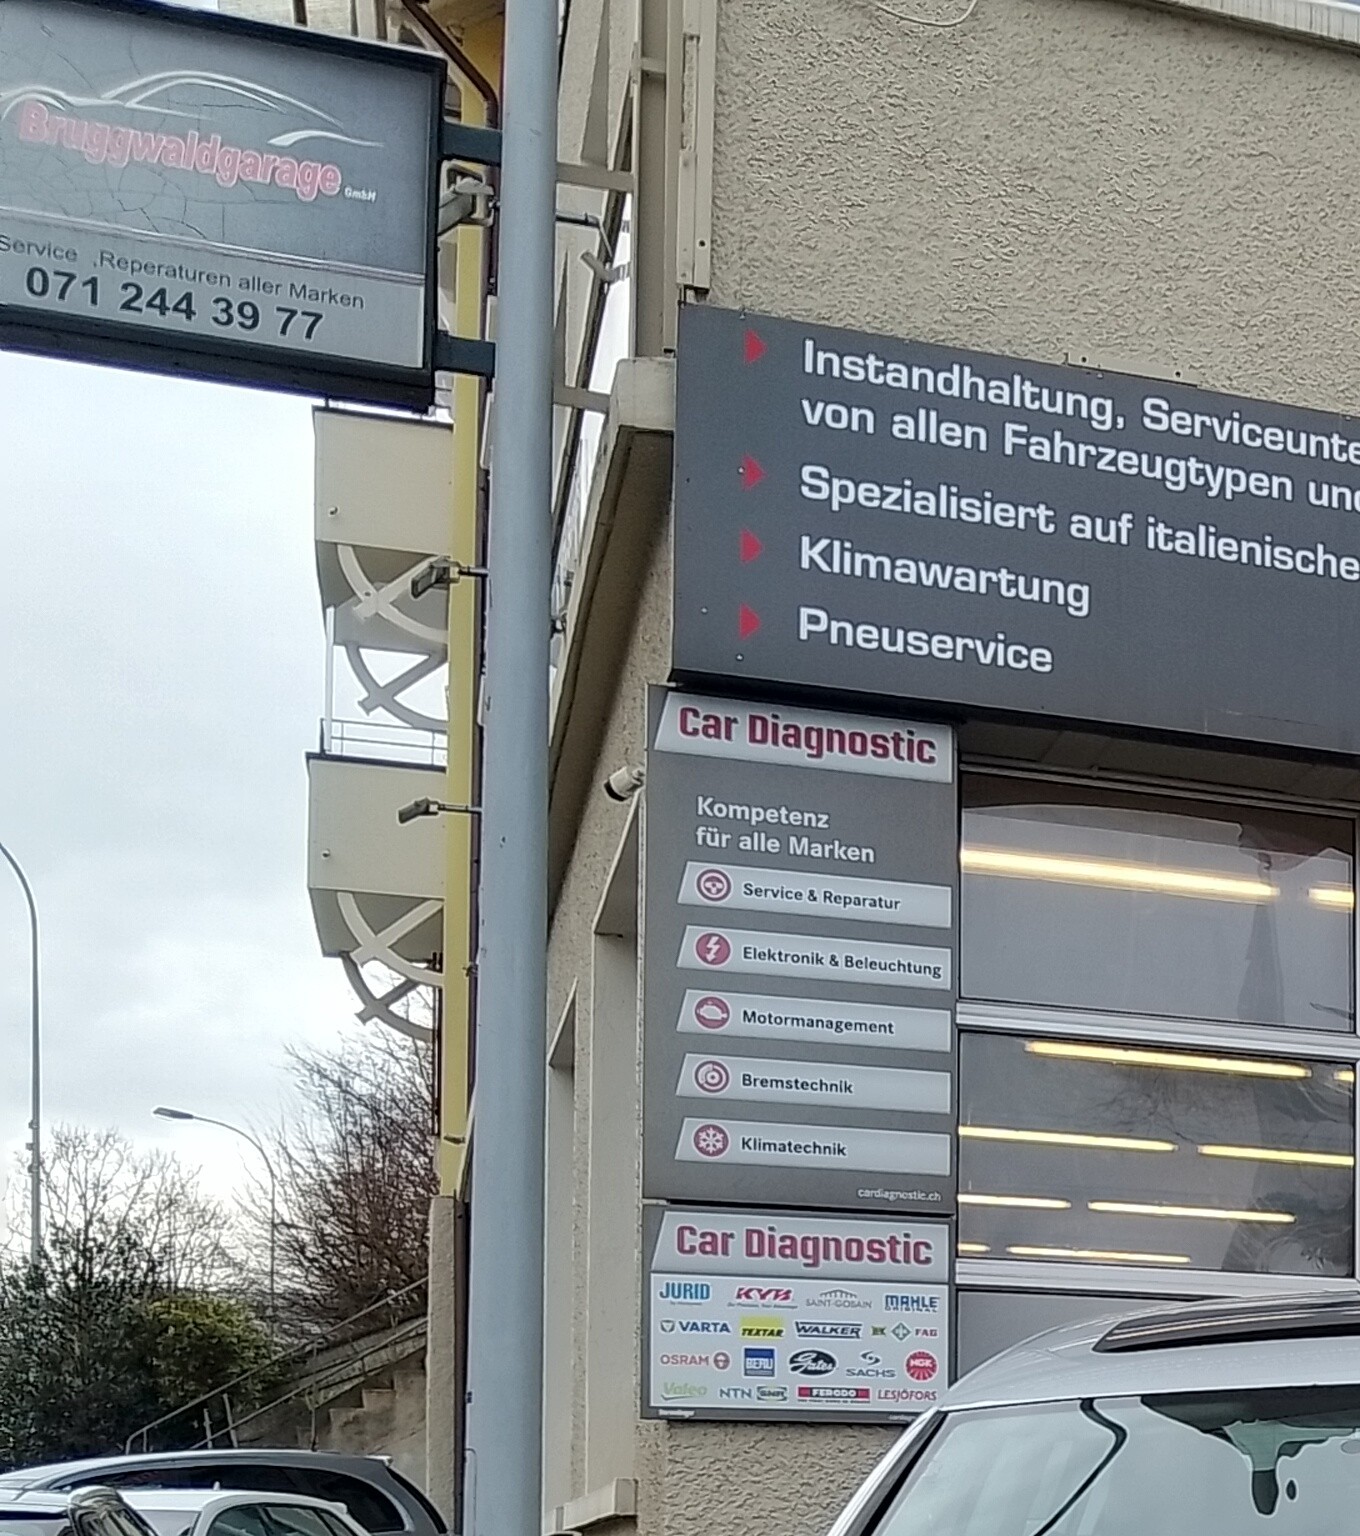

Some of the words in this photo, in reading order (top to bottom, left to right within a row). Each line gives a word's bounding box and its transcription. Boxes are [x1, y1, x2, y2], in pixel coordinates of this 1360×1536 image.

[18, 102, 342, 201] Bruggwaldgarage
[0, 233, 78, 262] Service
[238, 274, 283, 297] aller
[289, 281, 365, 310] Marken
[26, 267, 99, 306] 071
[119, 282, 197, 321] 244
[211, 299, 261, 331] 39
[275, 306, 324, 341] 77
[802, 338, 1126, 432] Instandhaltung,
[801, 397, 875, 435] von
[891, 409, 988, 454] allen
[1004, 422, 1293, 504] Fahrzeugtypen
[800, 466, 1055, 536] Spezialisiert
[1069, 510, 1134, 548] auf
[800, 536, 1091, 618] Klimawartung
[798, 608, 1053, 673] Pneuservice
[679, 706, 739, 742] Car
[748, 714, 936, 764] Diagnostic
[696, 796, 830, 829] Kompetenz
[696, 827, 731, 848] für
[739, 832, 780, 853] alle
[789, 836, 875, 863] Marken
[743, 883, 804, 901] Service
[807, 889, 819, 902] &
[823, 891, 901, 911] Reparatur
[743, 946, 824, 966] Elektronik
[829, 954, 840, 967] &
[844, 955, 942, 979] Beleuchtung
[742, 1009, 895, 1035] Motormanagement
[742, 1073, 853, 1094] Bremstechnik
[741, 1137, 847, 1156] Klimatechnik
[676, 1225, 735, 1257] Car
[745, 1226, 932, 1268] Diagnostic
[659, 1282, 710, 1300] JURID
[736, 1287, 792, 1301] KYB
[885, 1294, 940, 1308] MAHLE
[679, 1320, 730, 1333] VARTA
[741, 1328, 784, 1338] TEXTAR
[795, 1321, 861, 1338] WALKER
[660, 1354, 709, 1366] OSRAM
[846, 1368, 896, 1378] SACHS
[719, 1387, 752, 1399] NTN
